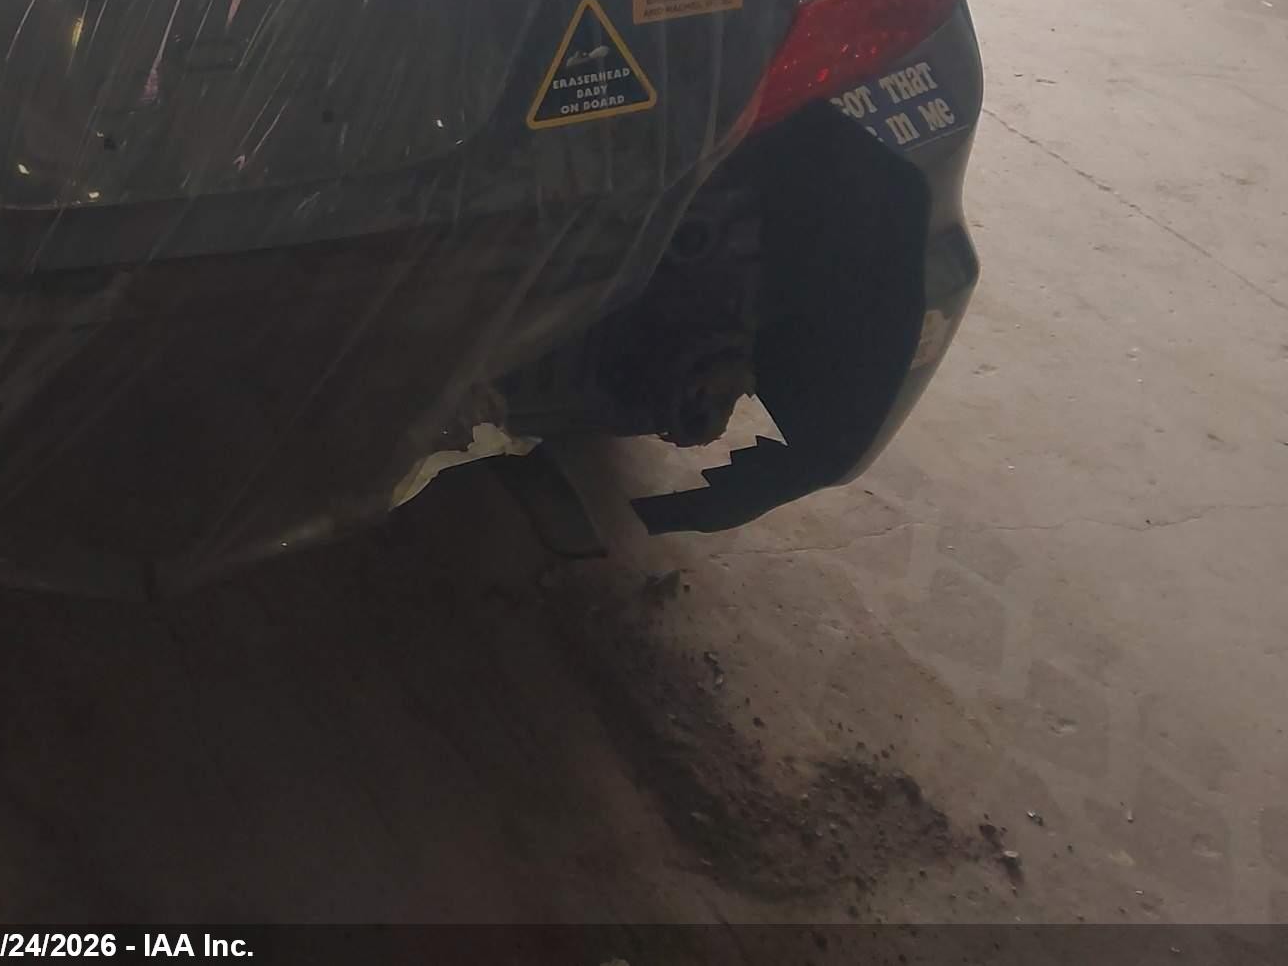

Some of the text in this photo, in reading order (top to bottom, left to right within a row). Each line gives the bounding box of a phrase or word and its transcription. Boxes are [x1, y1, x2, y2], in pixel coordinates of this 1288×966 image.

[552, 67, 631, 90] ERASERHEAD
[576, 84, 608, 99] BABY
[560, 95, 626, 115] ON BOARD
